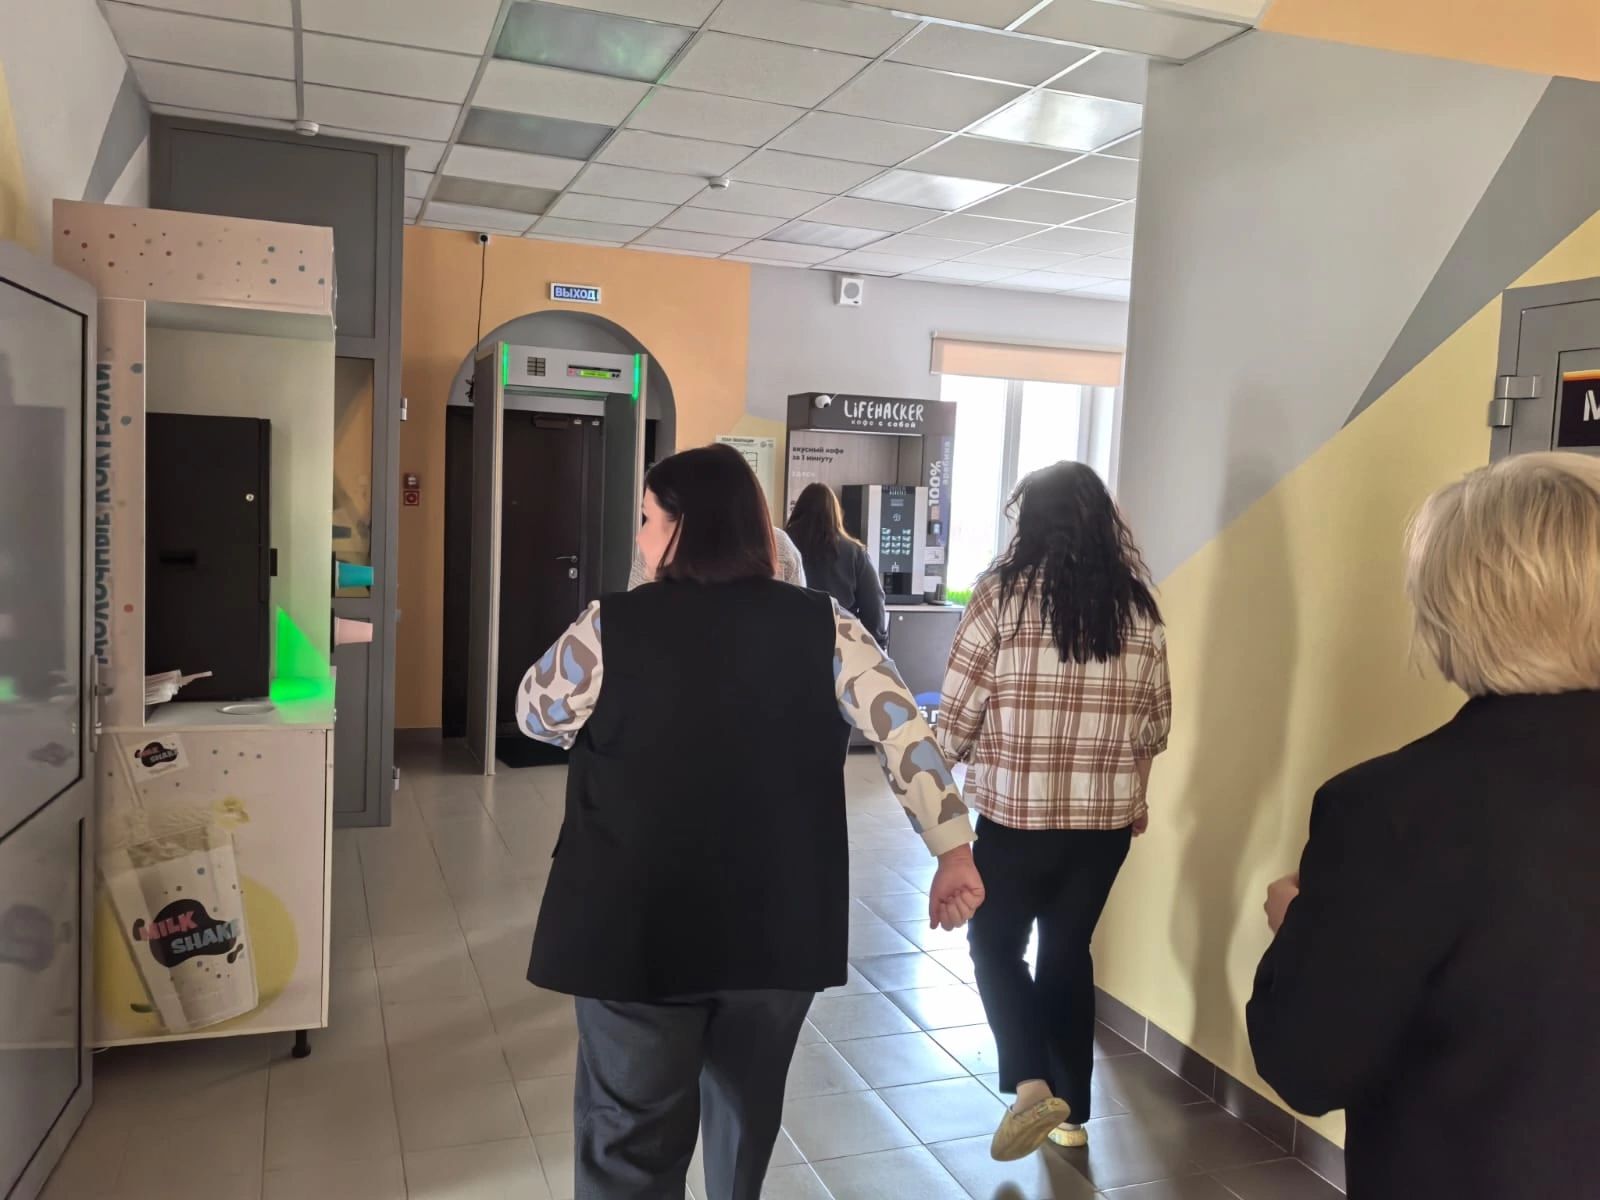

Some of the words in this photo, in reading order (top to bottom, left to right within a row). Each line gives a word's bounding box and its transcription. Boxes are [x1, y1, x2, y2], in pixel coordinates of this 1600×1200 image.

[555, 287, 596, 300] ВЫХОД
[851, 419, 874, 427] кофе
[887, 420, 916, 428] собой
[928, 460, 942, 507] 100%
[139, 911, 199, 940] MILK
